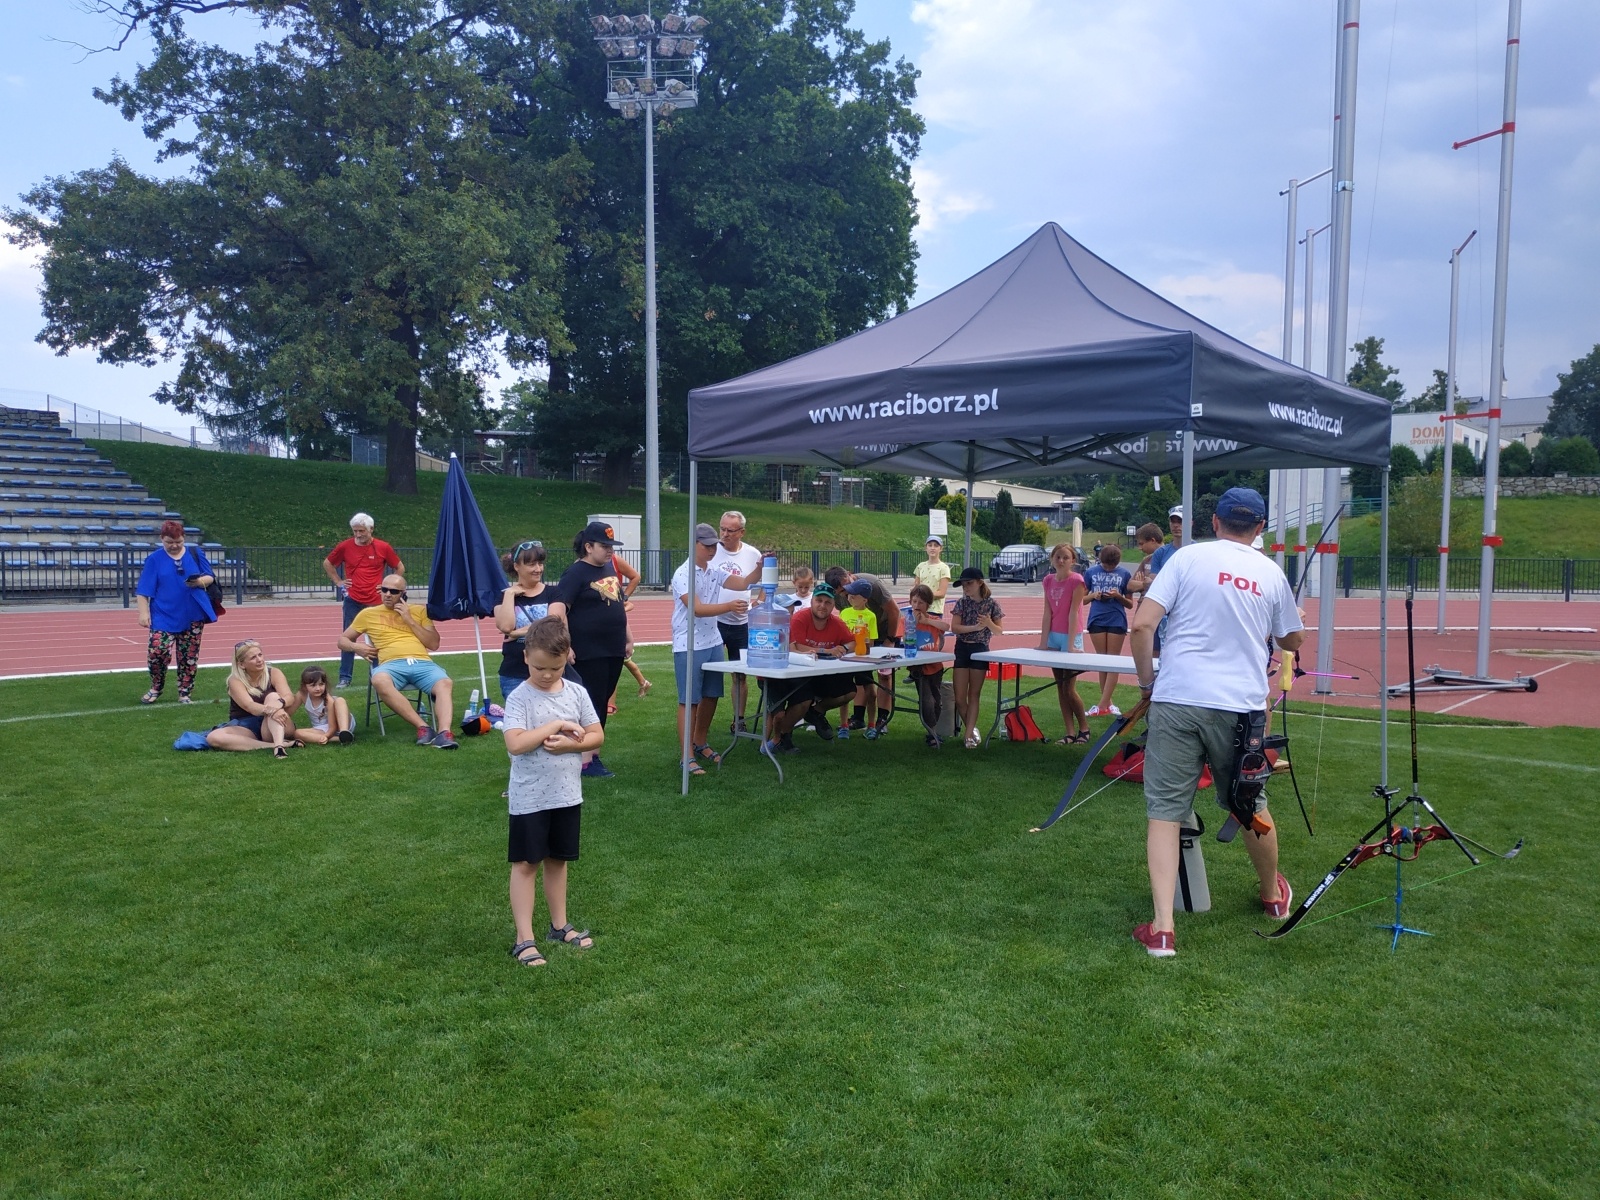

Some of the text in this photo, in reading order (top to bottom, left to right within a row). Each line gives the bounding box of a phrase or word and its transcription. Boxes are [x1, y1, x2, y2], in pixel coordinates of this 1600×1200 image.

[808, 387, 999, 425] www.raciborz.pl
[1268, 401, 1344, 438] www.raciborz.pl
[1410, 438, 1445, 446] SPORTOWC
[1412, 426, 1445, 439] DOM
[1091, 573, 1123, 586] SWEAR
[1218, 572, 1262, 597] POL
